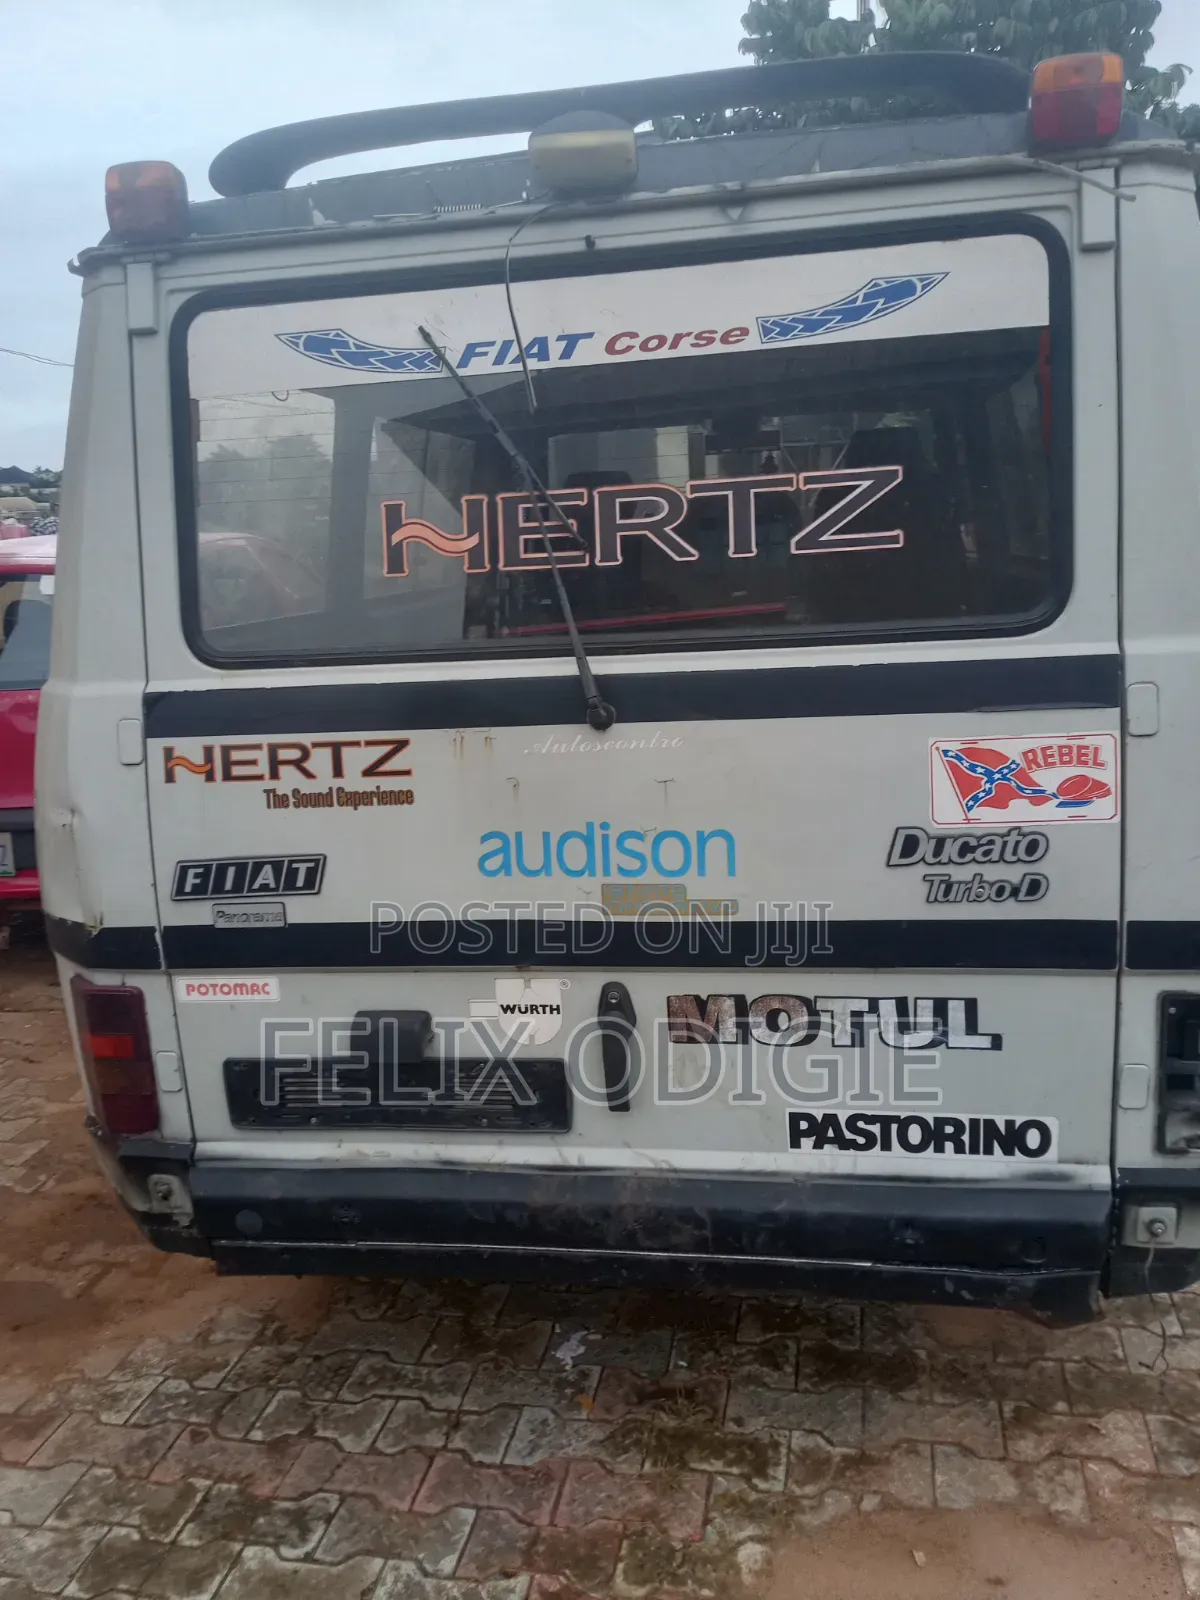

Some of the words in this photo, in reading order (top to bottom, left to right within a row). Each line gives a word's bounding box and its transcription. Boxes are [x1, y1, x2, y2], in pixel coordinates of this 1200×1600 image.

[456, 331, 595, 369] FIAT
[604, 326, 750, 355] Corse
[380, 465, 905, 577] HERTZ
[163, 738, 412, 784] HERTZ
[1021, 744, 1108, 773] REBEL
[263, 788, 290, 809] The
[292, 787, 334, 809] Sound
[336, 785, 414, 811] Experience
[478, 821, 736, 877] audison
[887, 826, 1049, 867] Ducato
[183, 862, 316, 893] FIAT
[185, 982, 271, 997] POTOMAC
[667, 994, 1003, 1051] MOTUL
[789, 1111, 1052, 1159] PASTORINO
